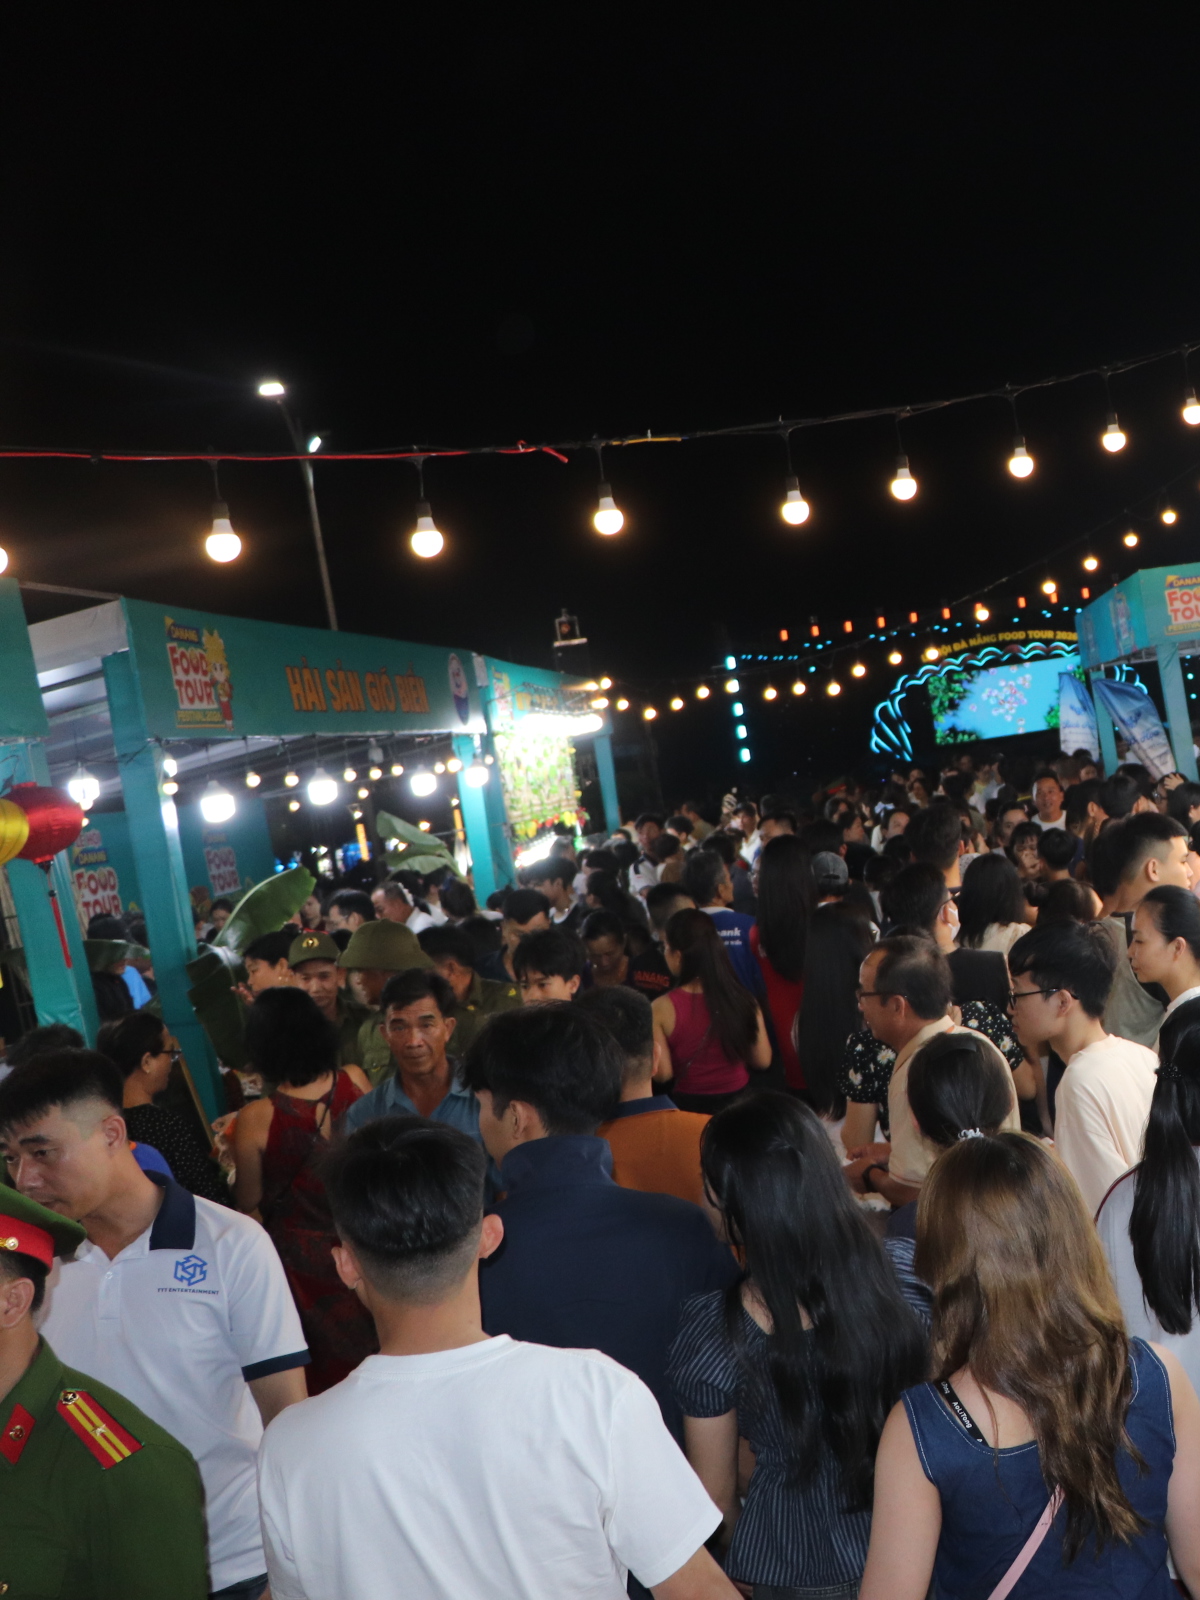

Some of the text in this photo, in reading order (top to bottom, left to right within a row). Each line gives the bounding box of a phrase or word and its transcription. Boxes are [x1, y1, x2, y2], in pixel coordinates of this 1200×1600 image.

[998, 631, 1026, 641] FOOD
[1027, 630, 1054, 640] TOUR
[168, 645, 209, 677] FOOD
[175, 679, 216, 706] TOUR
[75, 869, 117, 895] FOOD
